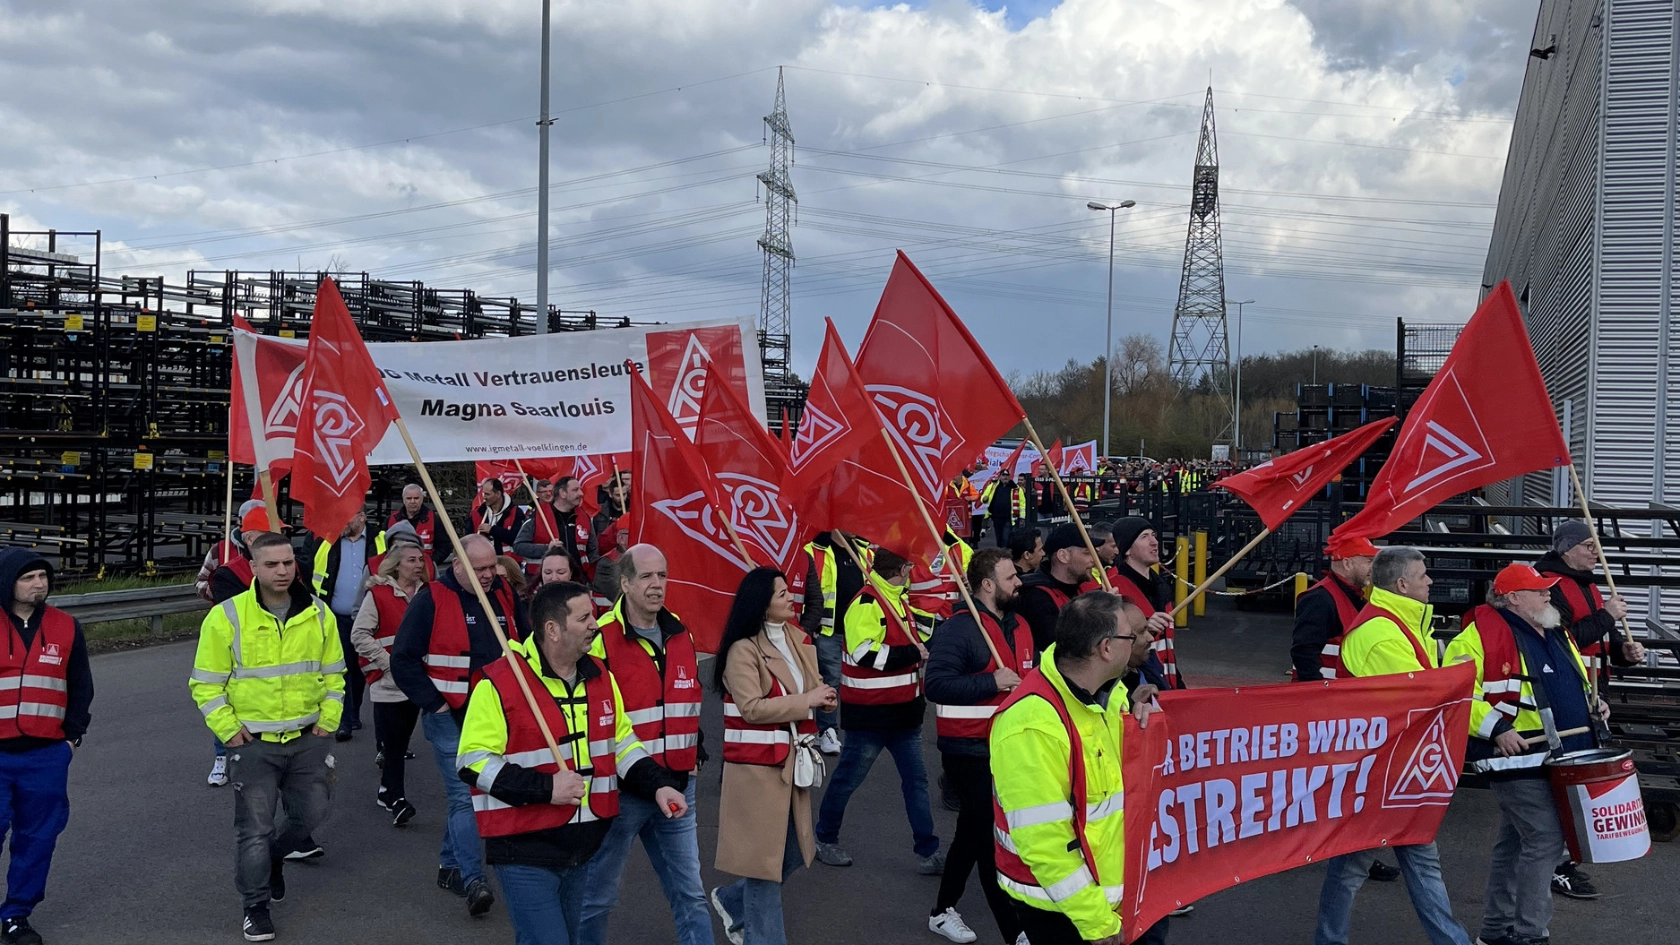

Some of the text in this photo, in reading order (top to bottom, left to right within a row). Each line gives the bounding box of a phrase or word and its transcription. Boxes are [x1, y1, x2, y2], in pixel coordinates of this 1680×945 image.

[404, 371, 470, 387] Metall
[473, 360, 644, 387] Vertrauensleute
[421, 398, 615, 421] Magna Saarlouis
[465, 443, 588, 454] www.igmetall-voelklingen.de
[1178, 722, 1299, 772] BETRIEB
[1307, 716, 1388, 755] WIRD
[1148, 754, 1378, 872] ESTREIKT!
[1591, 797, 1644, 818] SOLIDARIT
[1593, 810, 1647, 833] GEWINN
